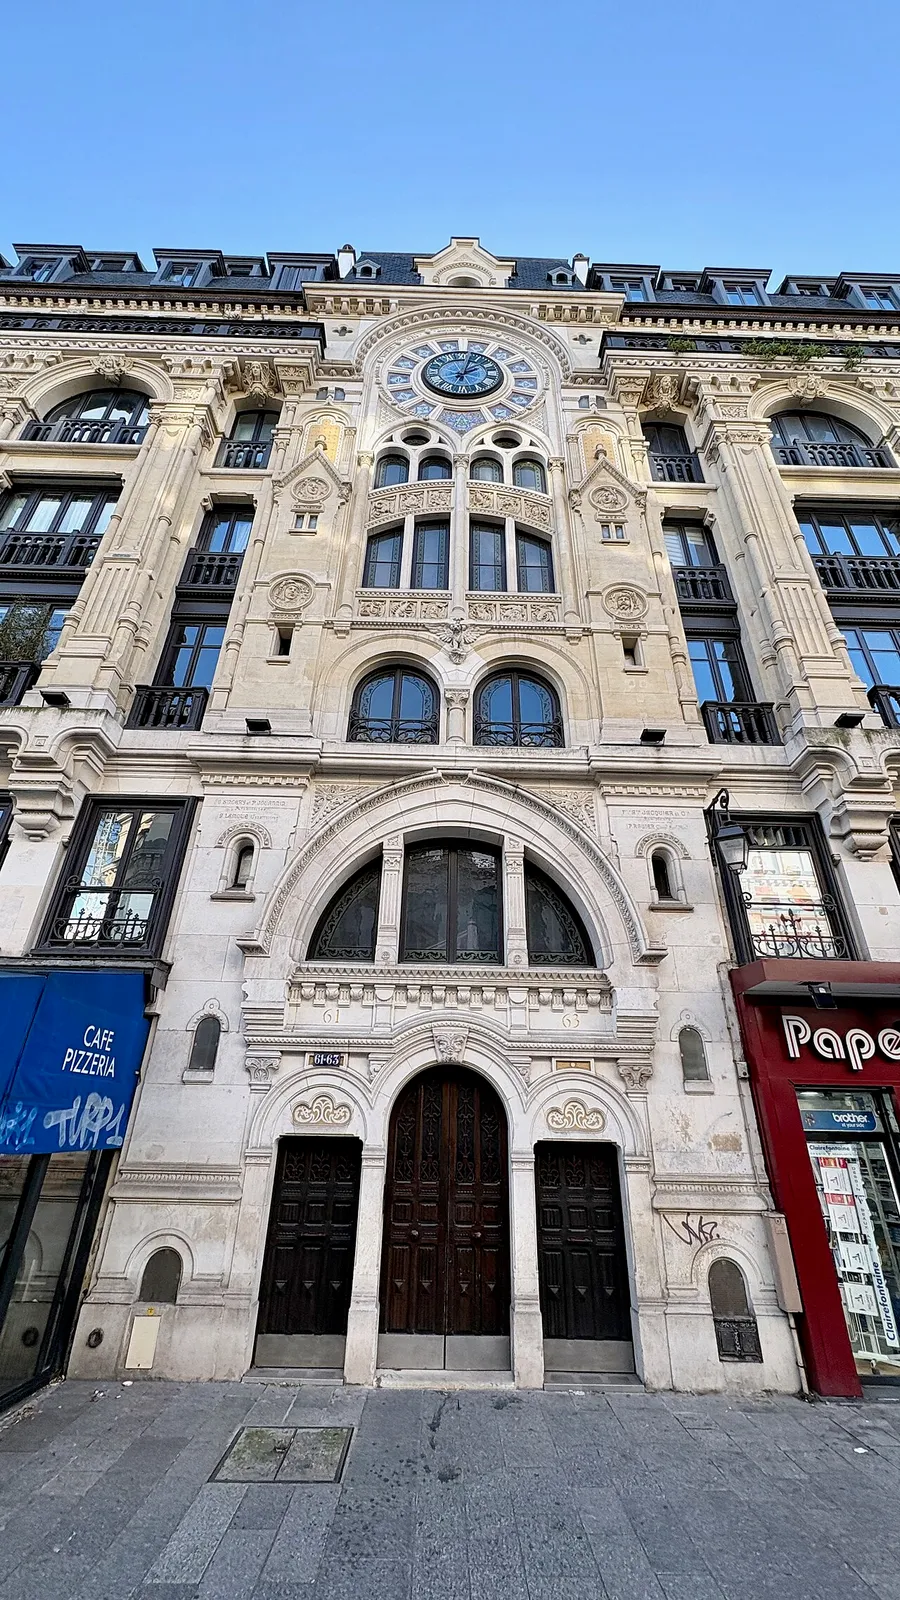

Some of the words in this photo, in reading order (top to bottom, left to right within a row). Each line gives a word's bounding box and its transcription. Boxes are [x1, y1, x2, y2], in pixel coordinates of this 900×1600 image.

[323, 1008, 339, 1023] 61
[562, 1013, 580, 1029] 63
[83, 1025, 115, 1051] CAFE
[781, 1014, 900, 1071] Pape
[61, 1048, 115, 1078] PIZZERIA
[831, 1112, 868, 1123] brother
[872, 1261, 896, 1341] Clairefontaine
